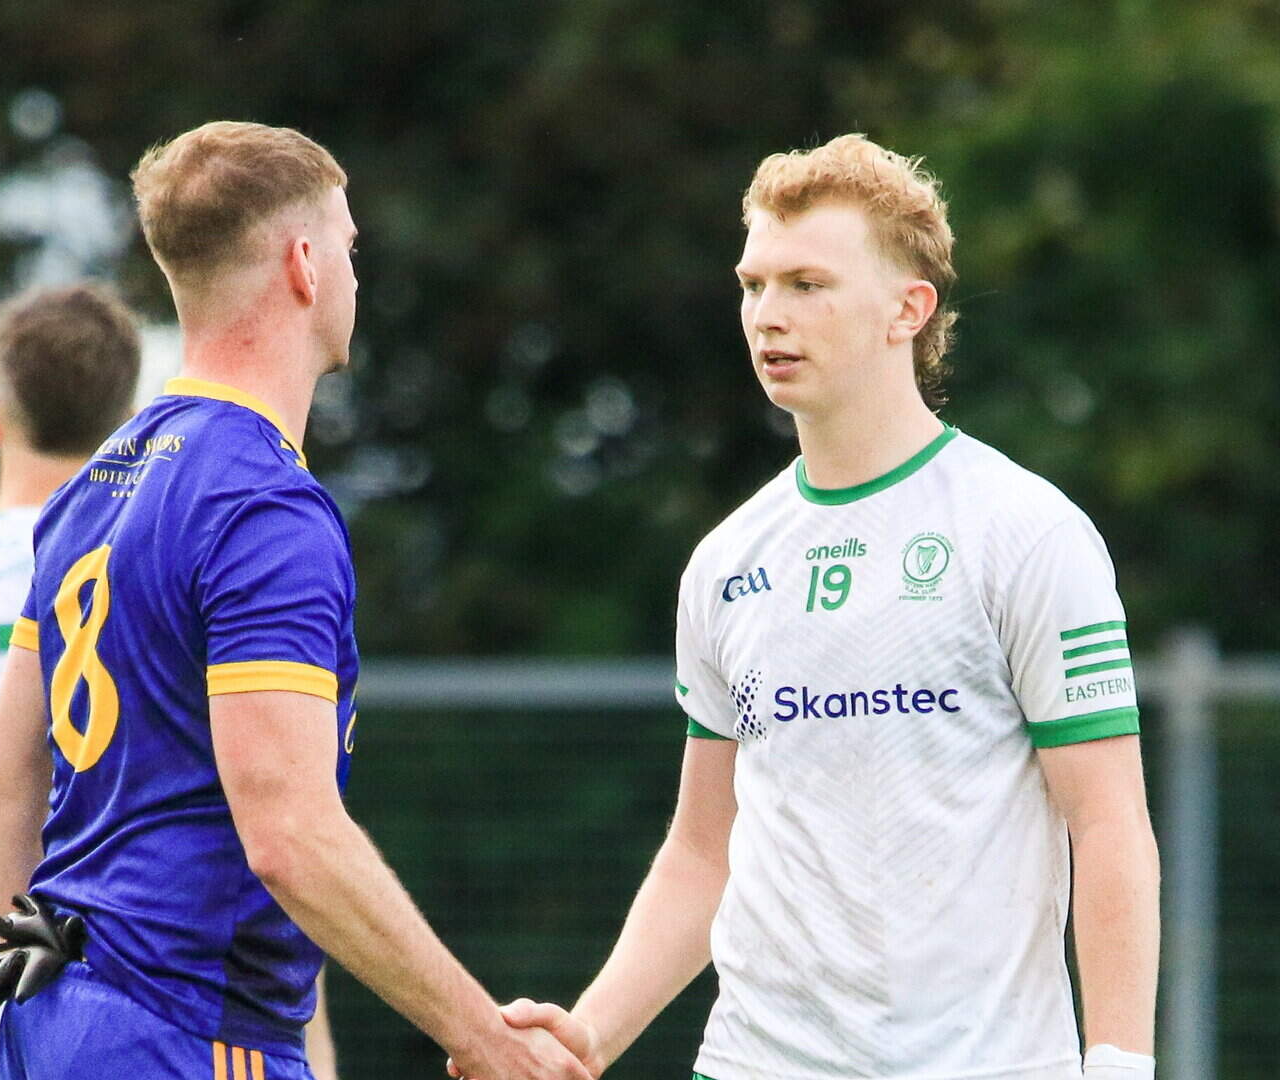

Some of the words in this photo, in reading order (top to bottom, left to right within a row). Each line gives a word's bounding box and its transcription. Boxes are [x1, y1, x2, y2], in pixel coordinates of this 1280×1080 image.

[805, 537, 867, 561] oneills
[805, 563, 852, 613] 19
[50, 543, 120, 773] 8
[773, 683, 961, 722] Skanstec
